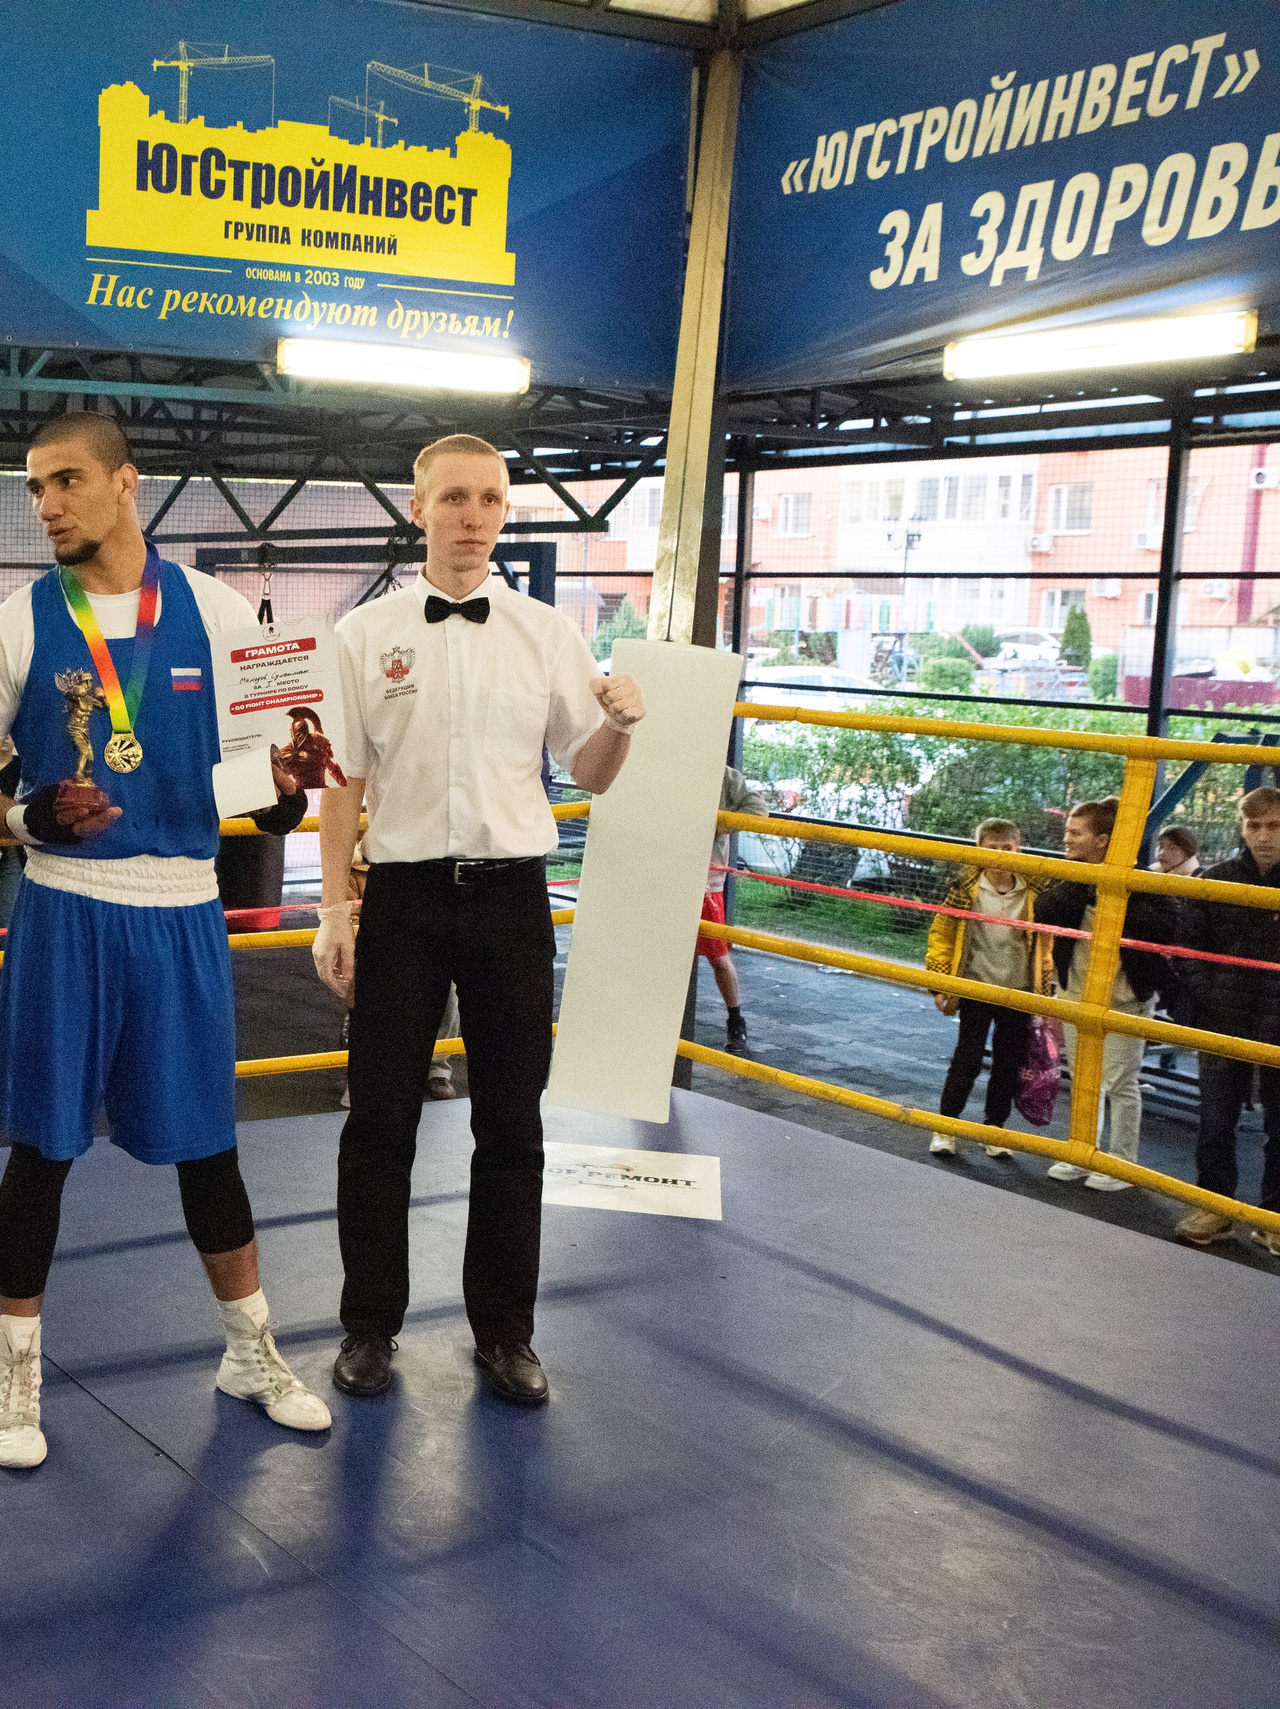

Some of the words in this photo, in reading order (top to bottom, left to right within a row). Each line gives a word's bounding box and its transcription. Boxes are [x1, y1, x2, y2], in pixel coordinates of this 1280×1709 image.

[781, 32, 1261, 195] «ЮГСТРОЙИНВЕСТ»
[136, 139, 478, 227] ЮгСтройИнвест
[224, 220, 292, 246] ГРУППА
[301, 227, 398, 256] КОМПАНИЙ
[870, 202, 943, 290] ЗА
[304, 269, 340, 287] 2003
[86, 272, 152, 309] Нас
[158, 287, 378, 332] рекомендуют
[387, 299, 515, 339] друзьям!
[240, 655, 309, 671] НАГРАЖДАЕТСЯ
[245, 642, 300, 658] ГРАМОТА
